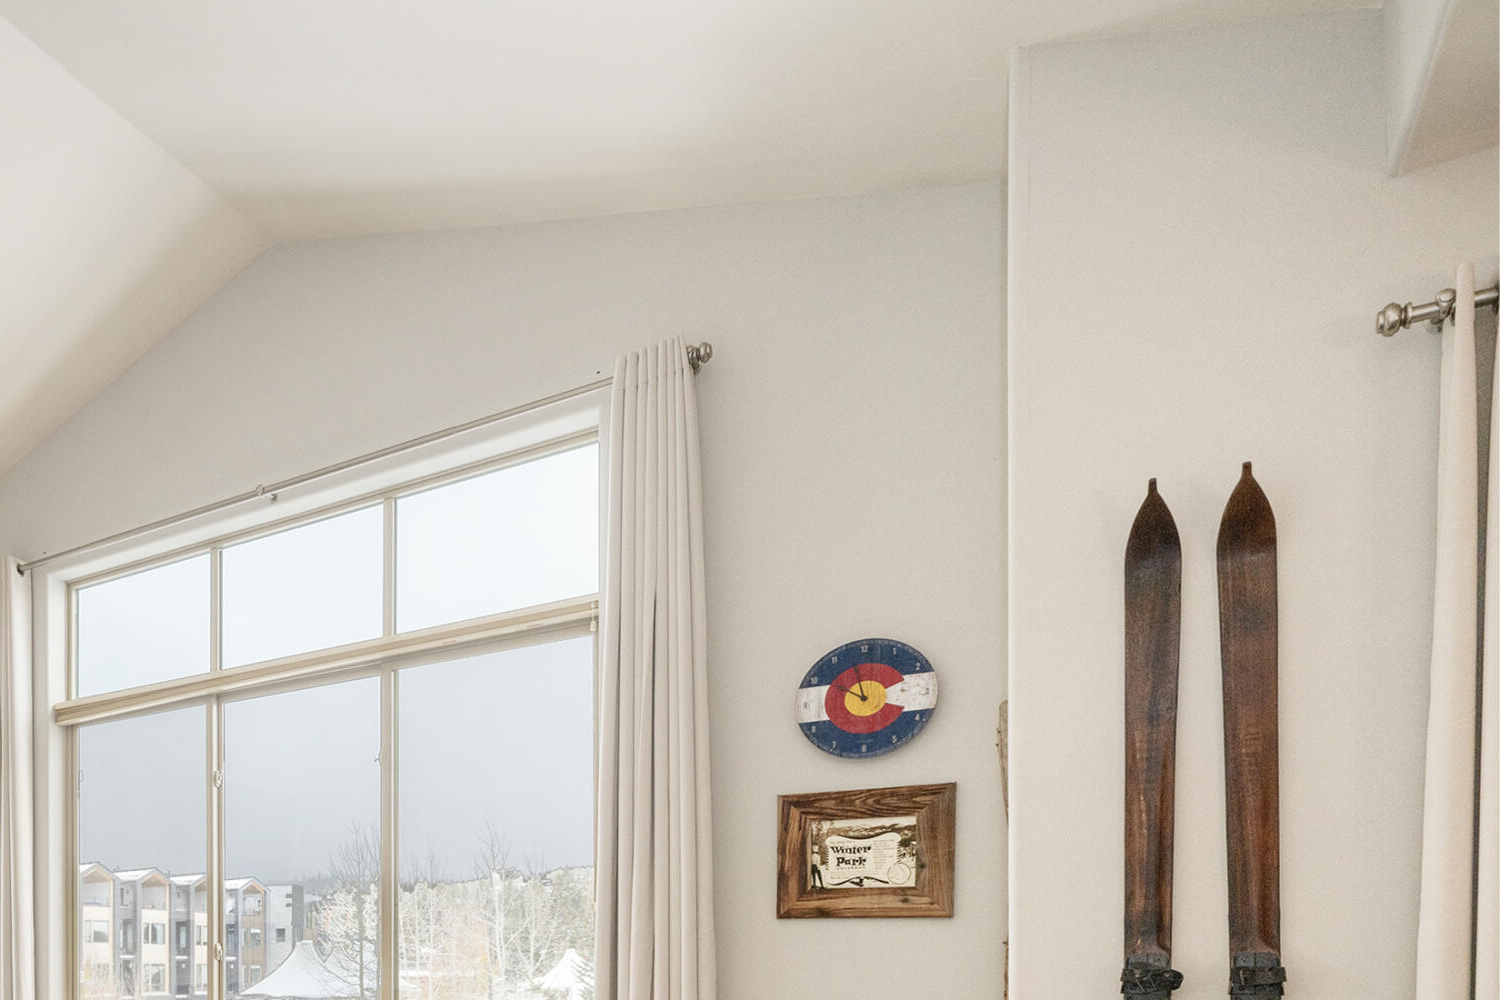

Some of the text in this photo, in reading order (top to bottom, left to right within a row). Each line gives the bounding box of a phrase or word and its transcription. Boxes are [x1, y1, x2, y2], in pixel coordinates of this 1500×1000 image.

[861, 645, 868, 653] 12
[832, 656, 838, 664] 11
[831, 845, 872, 855] Winter
[835, 856, 867, 867] Park
